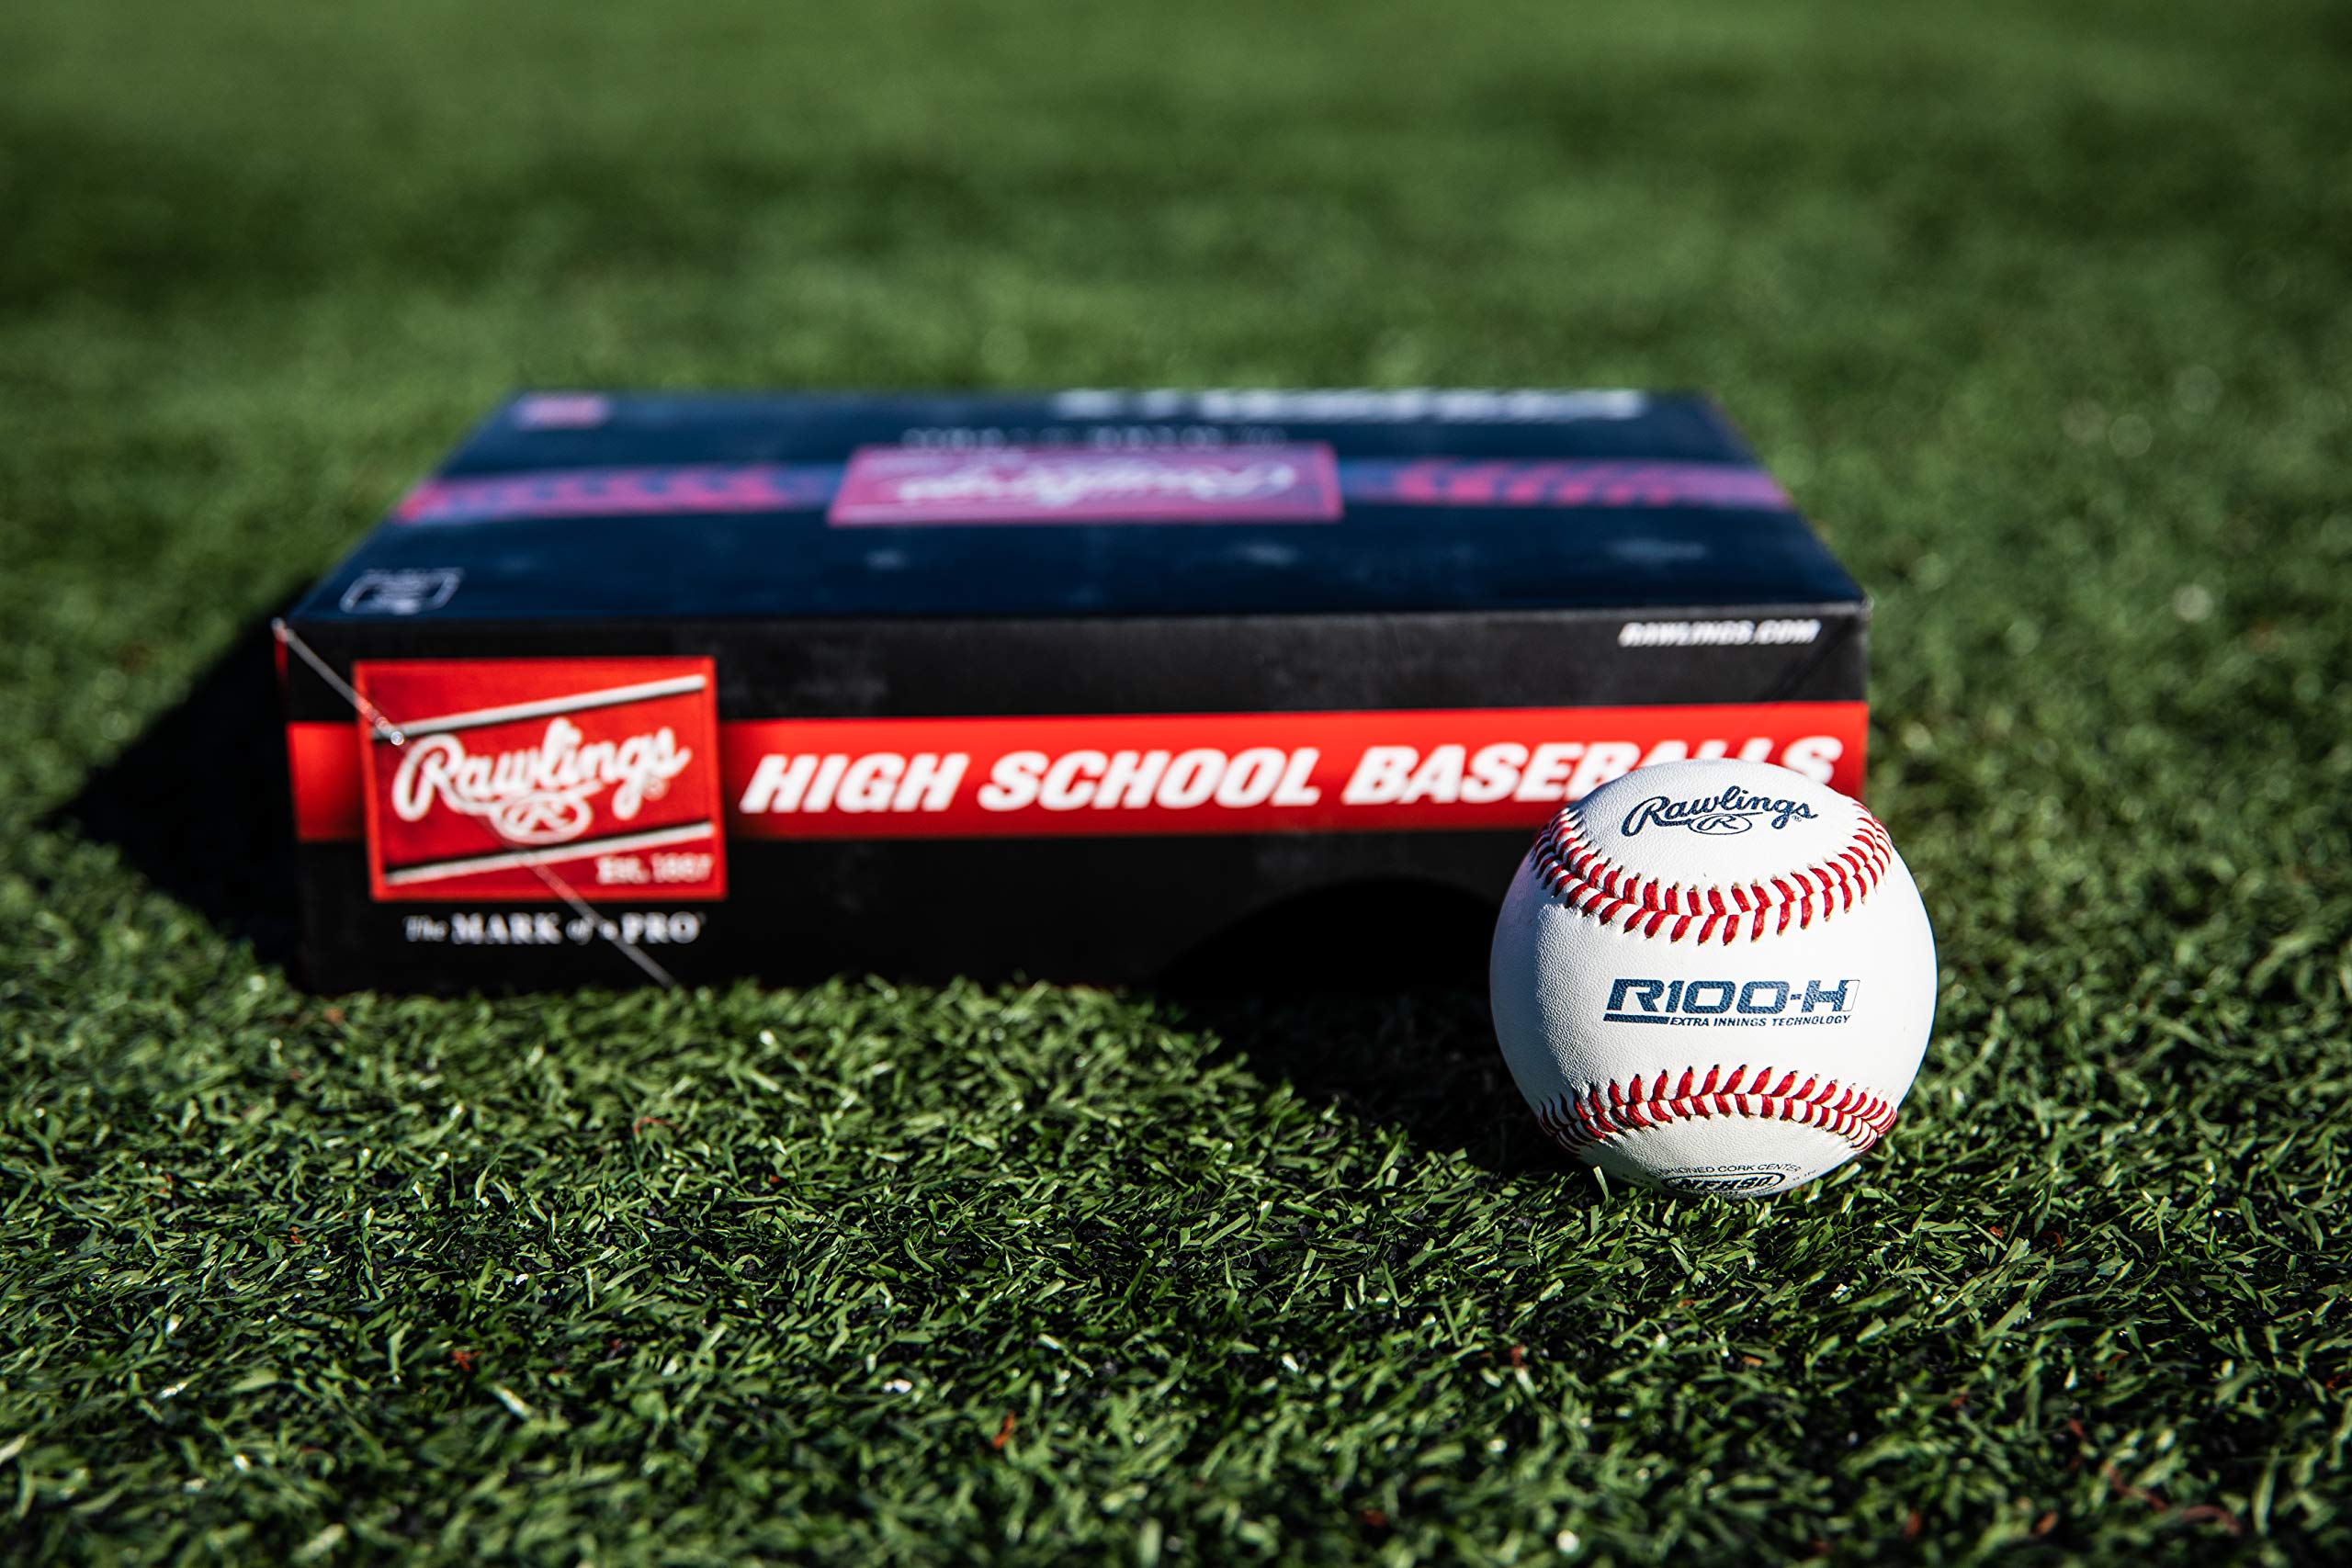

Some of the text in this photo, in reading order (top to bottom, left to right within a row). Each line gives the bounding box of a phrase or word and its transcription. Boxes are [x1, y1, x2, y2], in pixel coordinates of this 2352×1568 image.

[392, 716, 692, 821] Rawlings
[739, 751, 970, 813] HIGH
[978, 748, 1322, 811] SCHOOL
[1620, 784, 1818, 838] Rawlings
[451, 912, 563, 945] MARK
[621, 910, 701, 945] PRO
[1669, 1014, 1851, 1028] EXTRA INNINGS TECHNOLOGY
[1717, 1164, 1755, 1173] CORK
[1757, 1162, 1802, 1172] CENTER
